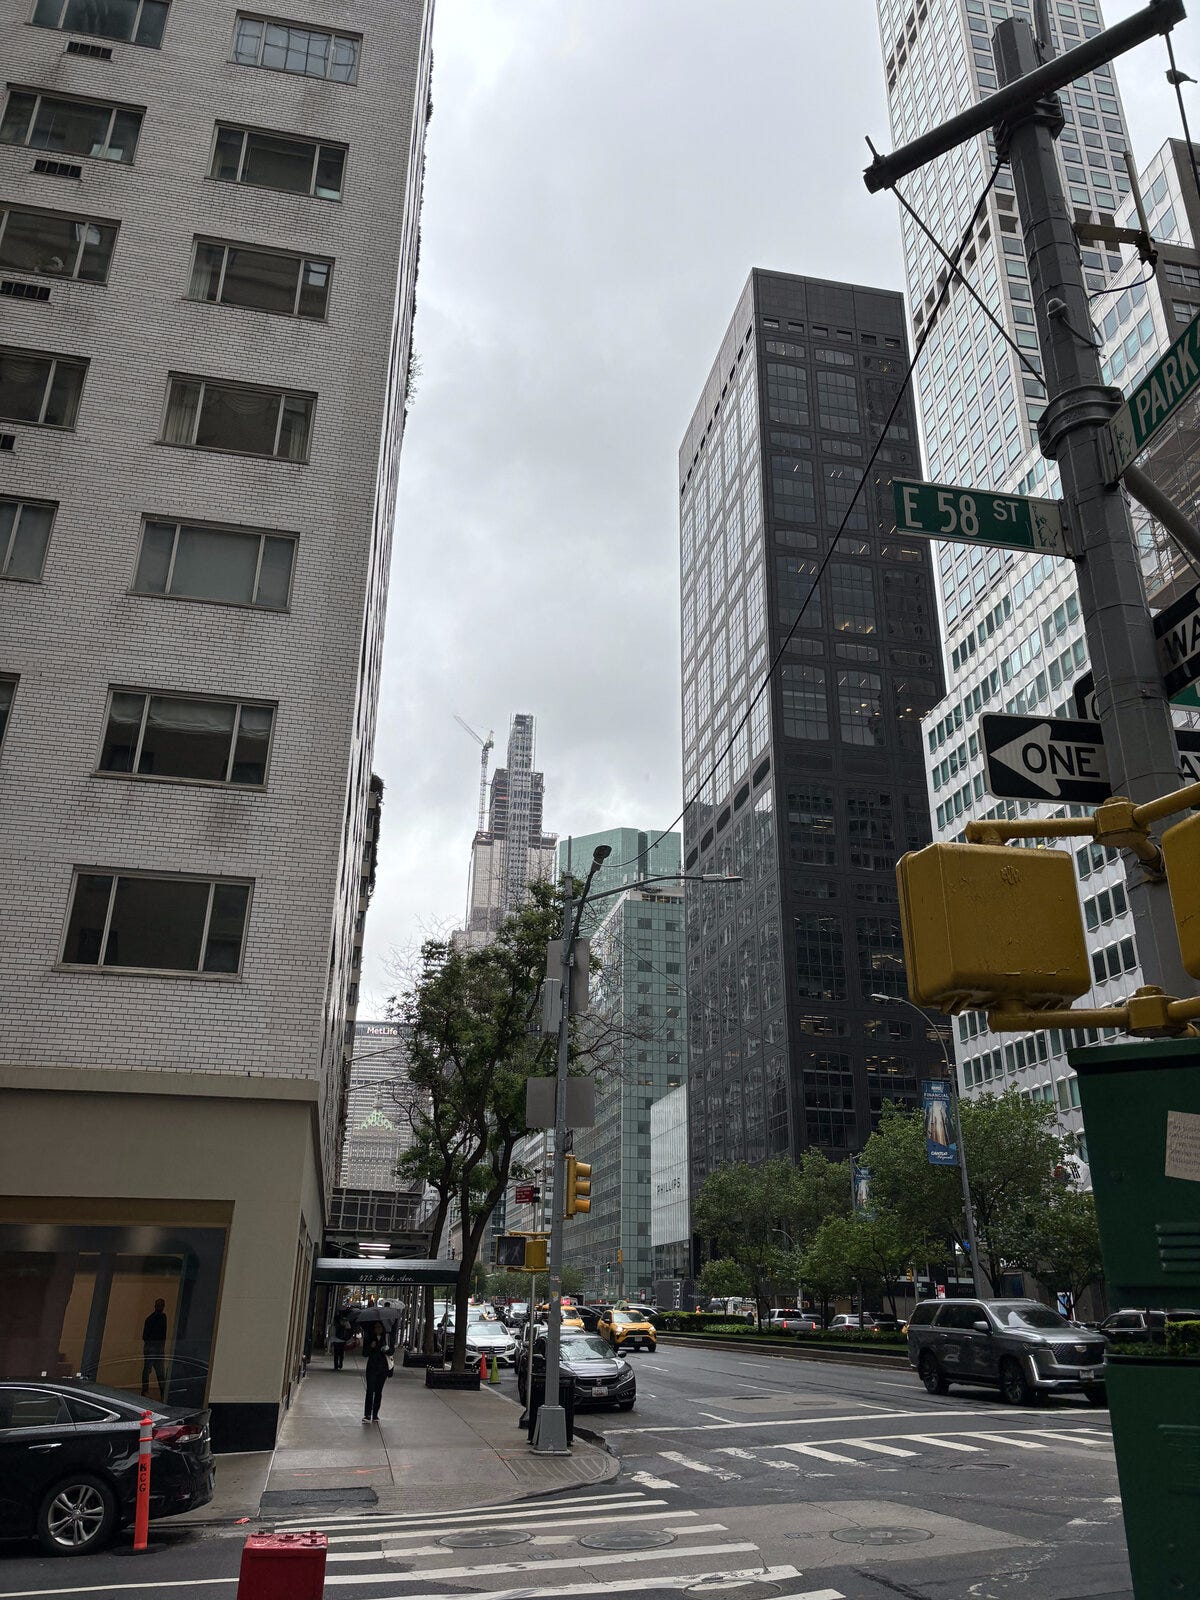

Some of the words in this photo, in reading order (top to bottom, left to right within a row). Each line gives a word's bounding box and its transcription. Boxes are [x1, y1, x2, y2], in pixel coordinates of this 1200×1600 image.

[1135, 333, 1199, 436] PARK
[903, 486, 923, 528] E
[937, 491, 980, 536] 58
[992, 499, 1019, 523] ST
[1021, 742, 1101, 778] ONE
[366, 1026, 398, 1036] MetLife
[656, 1177, 680, 1194] PHILLIPS
[376, 1273, 396, 1282] Park
